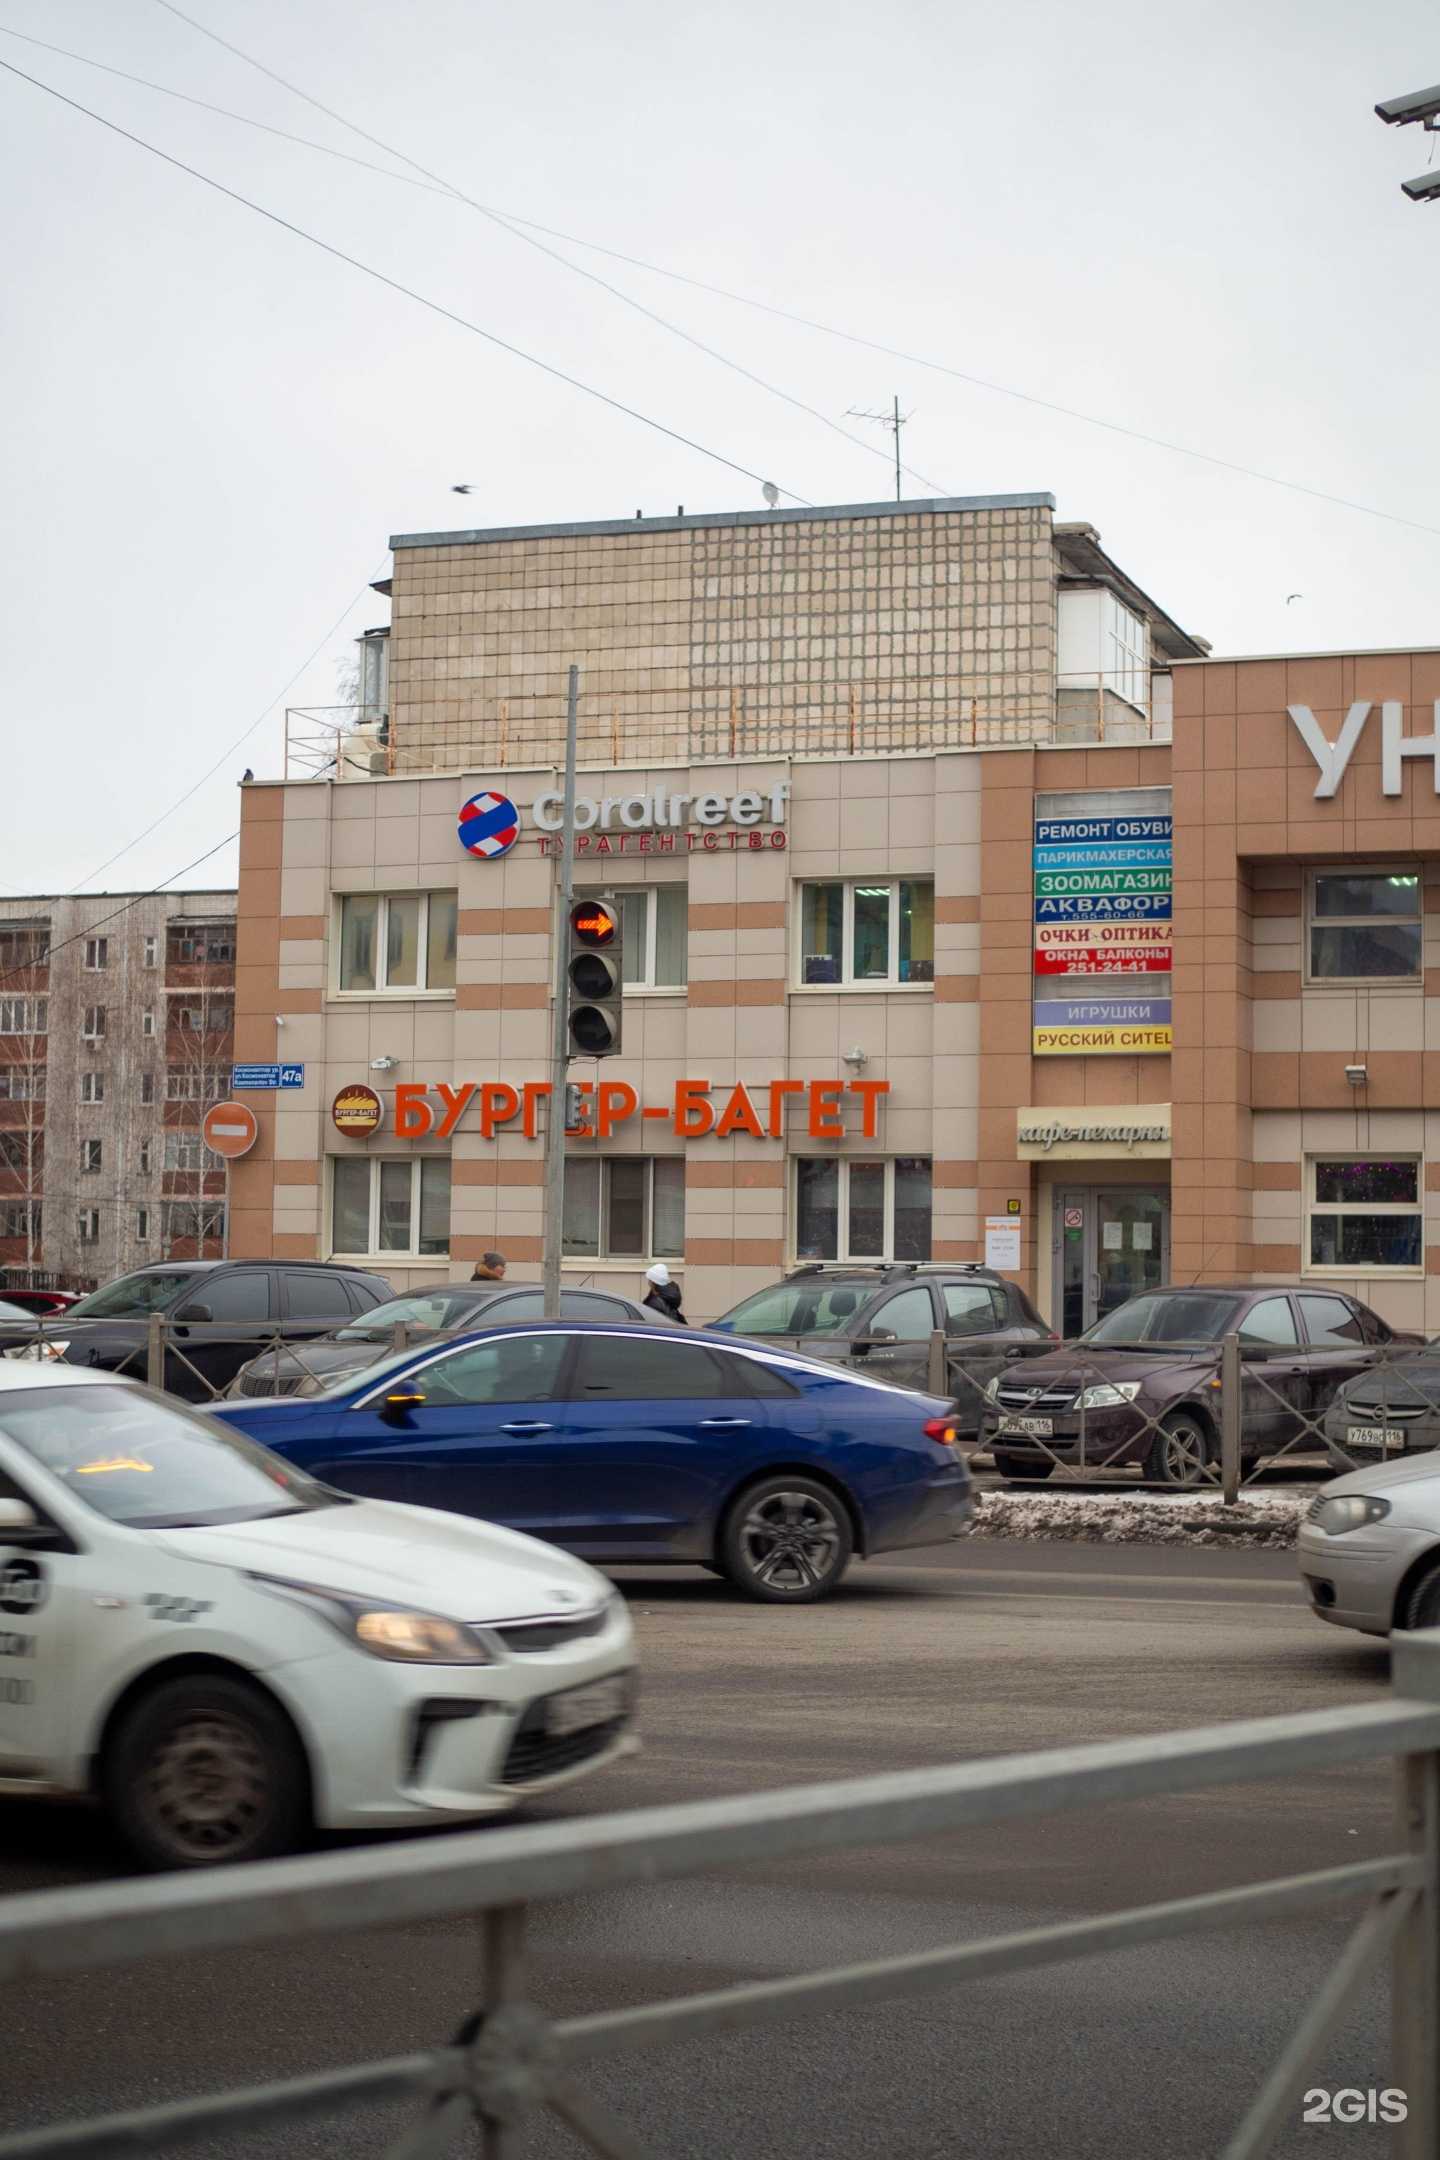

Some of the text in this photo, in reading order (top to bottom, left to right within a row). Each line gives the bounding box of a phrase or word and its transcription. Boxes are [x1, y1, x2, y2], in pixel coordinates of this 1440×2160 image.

[532, 779, 792, 831] Coralreef
[1039, 823, 1110, 839] РЕМОНТ
[1040, 896, 1169, 912] АКВАФОР
[1040, 929, 1090, 942] ОЧКИ
[1045, 949, 1169, 961] ОКНА БАЛКОНЫ
[1067, 961, 1148, 973] 251-24-41
[1068, 1006, 1151, 1019] ИГРУШКИ
[1038, 1031, 1114, 1046] РУССКИЙ
[1018, 1120, 1168, 1152] кафе-пекарня
